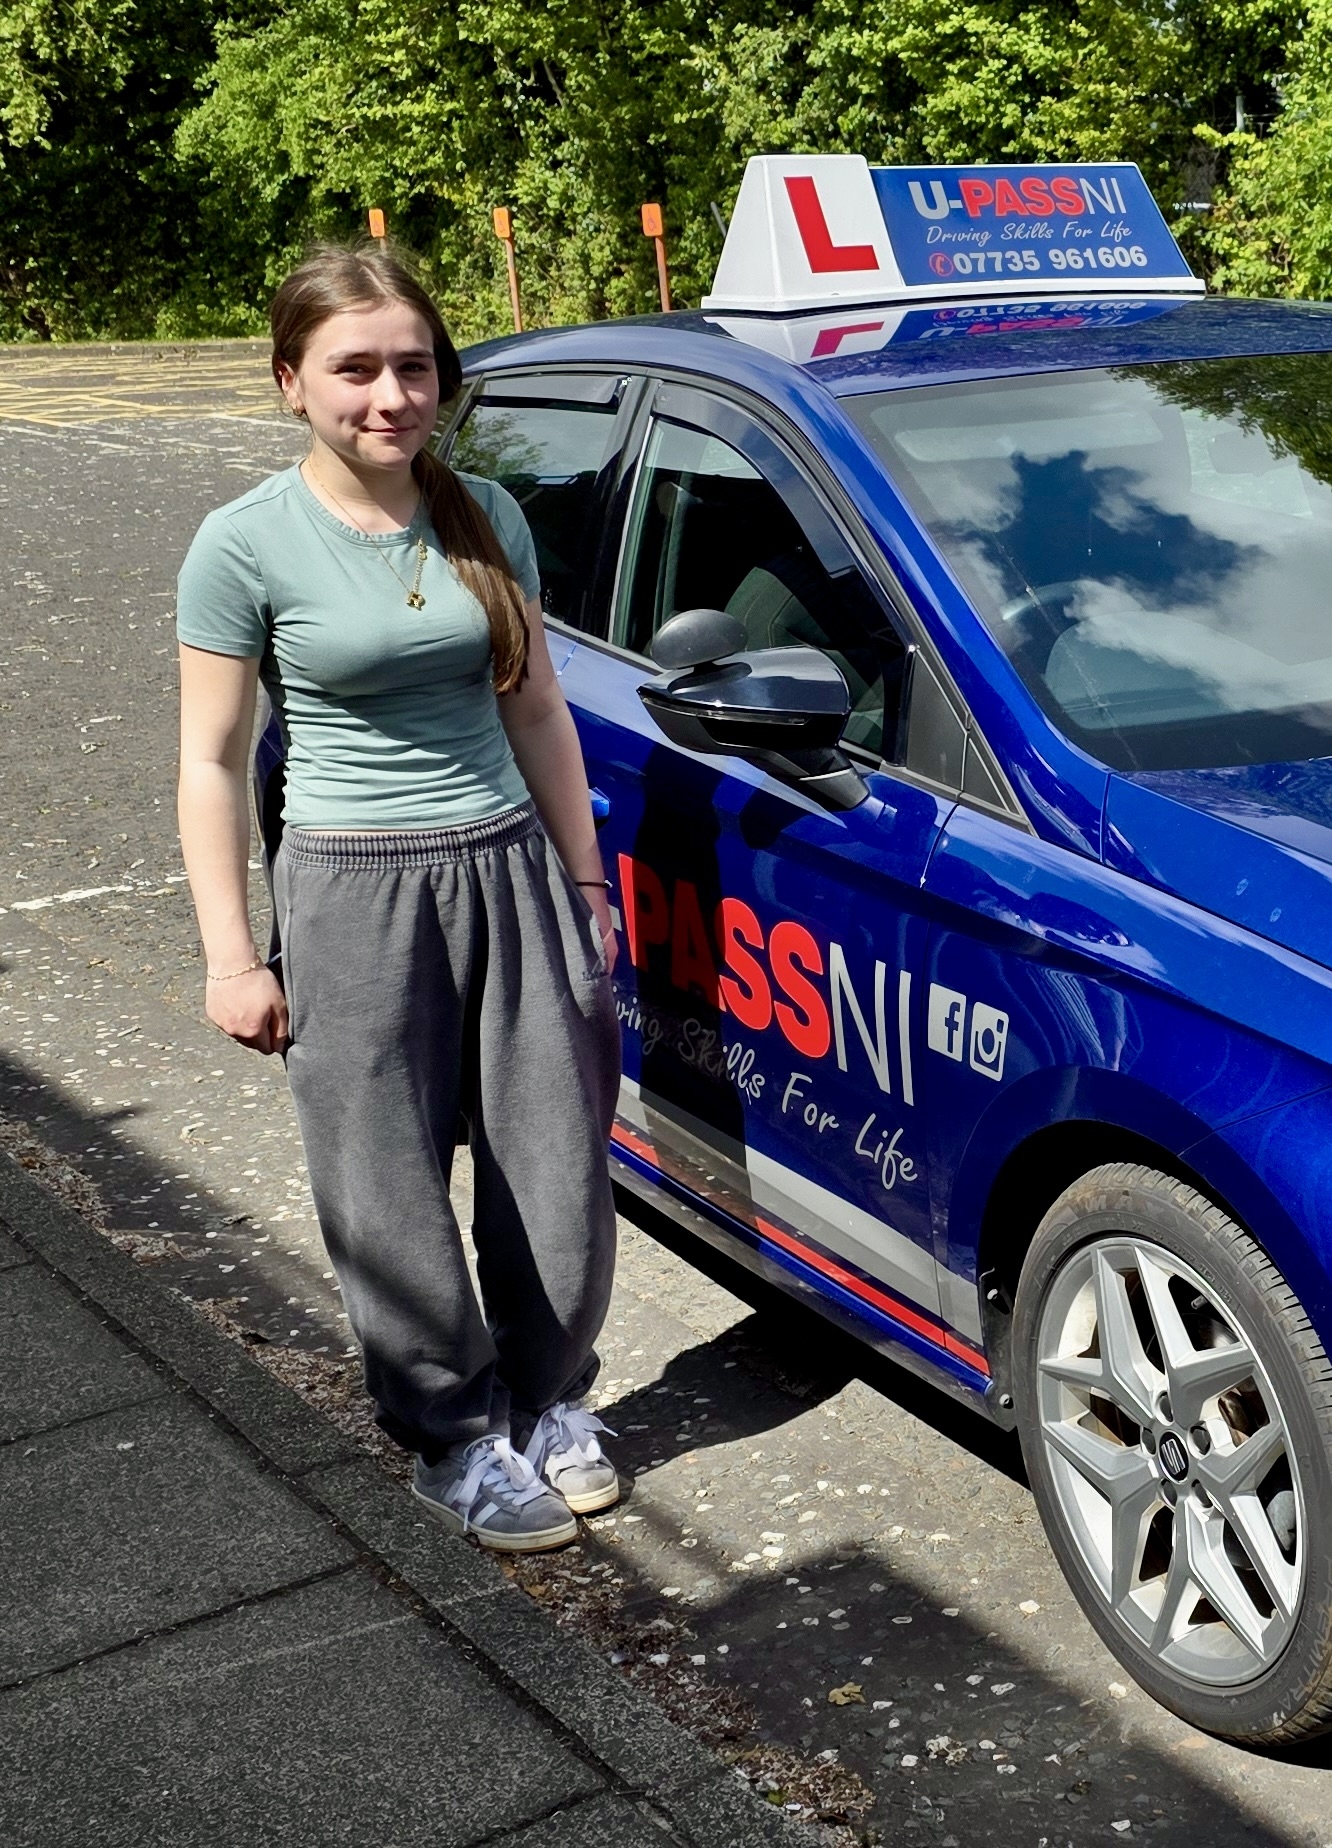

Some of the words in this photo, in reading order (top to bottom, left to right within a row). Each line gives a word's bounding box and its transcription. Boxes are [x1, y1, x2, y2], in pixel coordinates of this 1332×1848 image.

[784, 176, 880, 273] L
[908, 177, 1127, 220] U-PASSNI
[926, 225, 992, 247] Driving
[1000, 222, 1055, 242] Skills
[1062, 221, 1093, 239] For
[1100, 218, 1132, 243] Life
[953, 248, 1041, 274] 07735
[1049, 245, 1147, 271] 961606
[607, 852, 914, 1107] -PASSNI
[611, 985, 664, 1055] ving
[677, 1018, 766, 1100] Skills
[782, 1071, 839, 1133] For
[855, 1113, 918, 1190] Life
